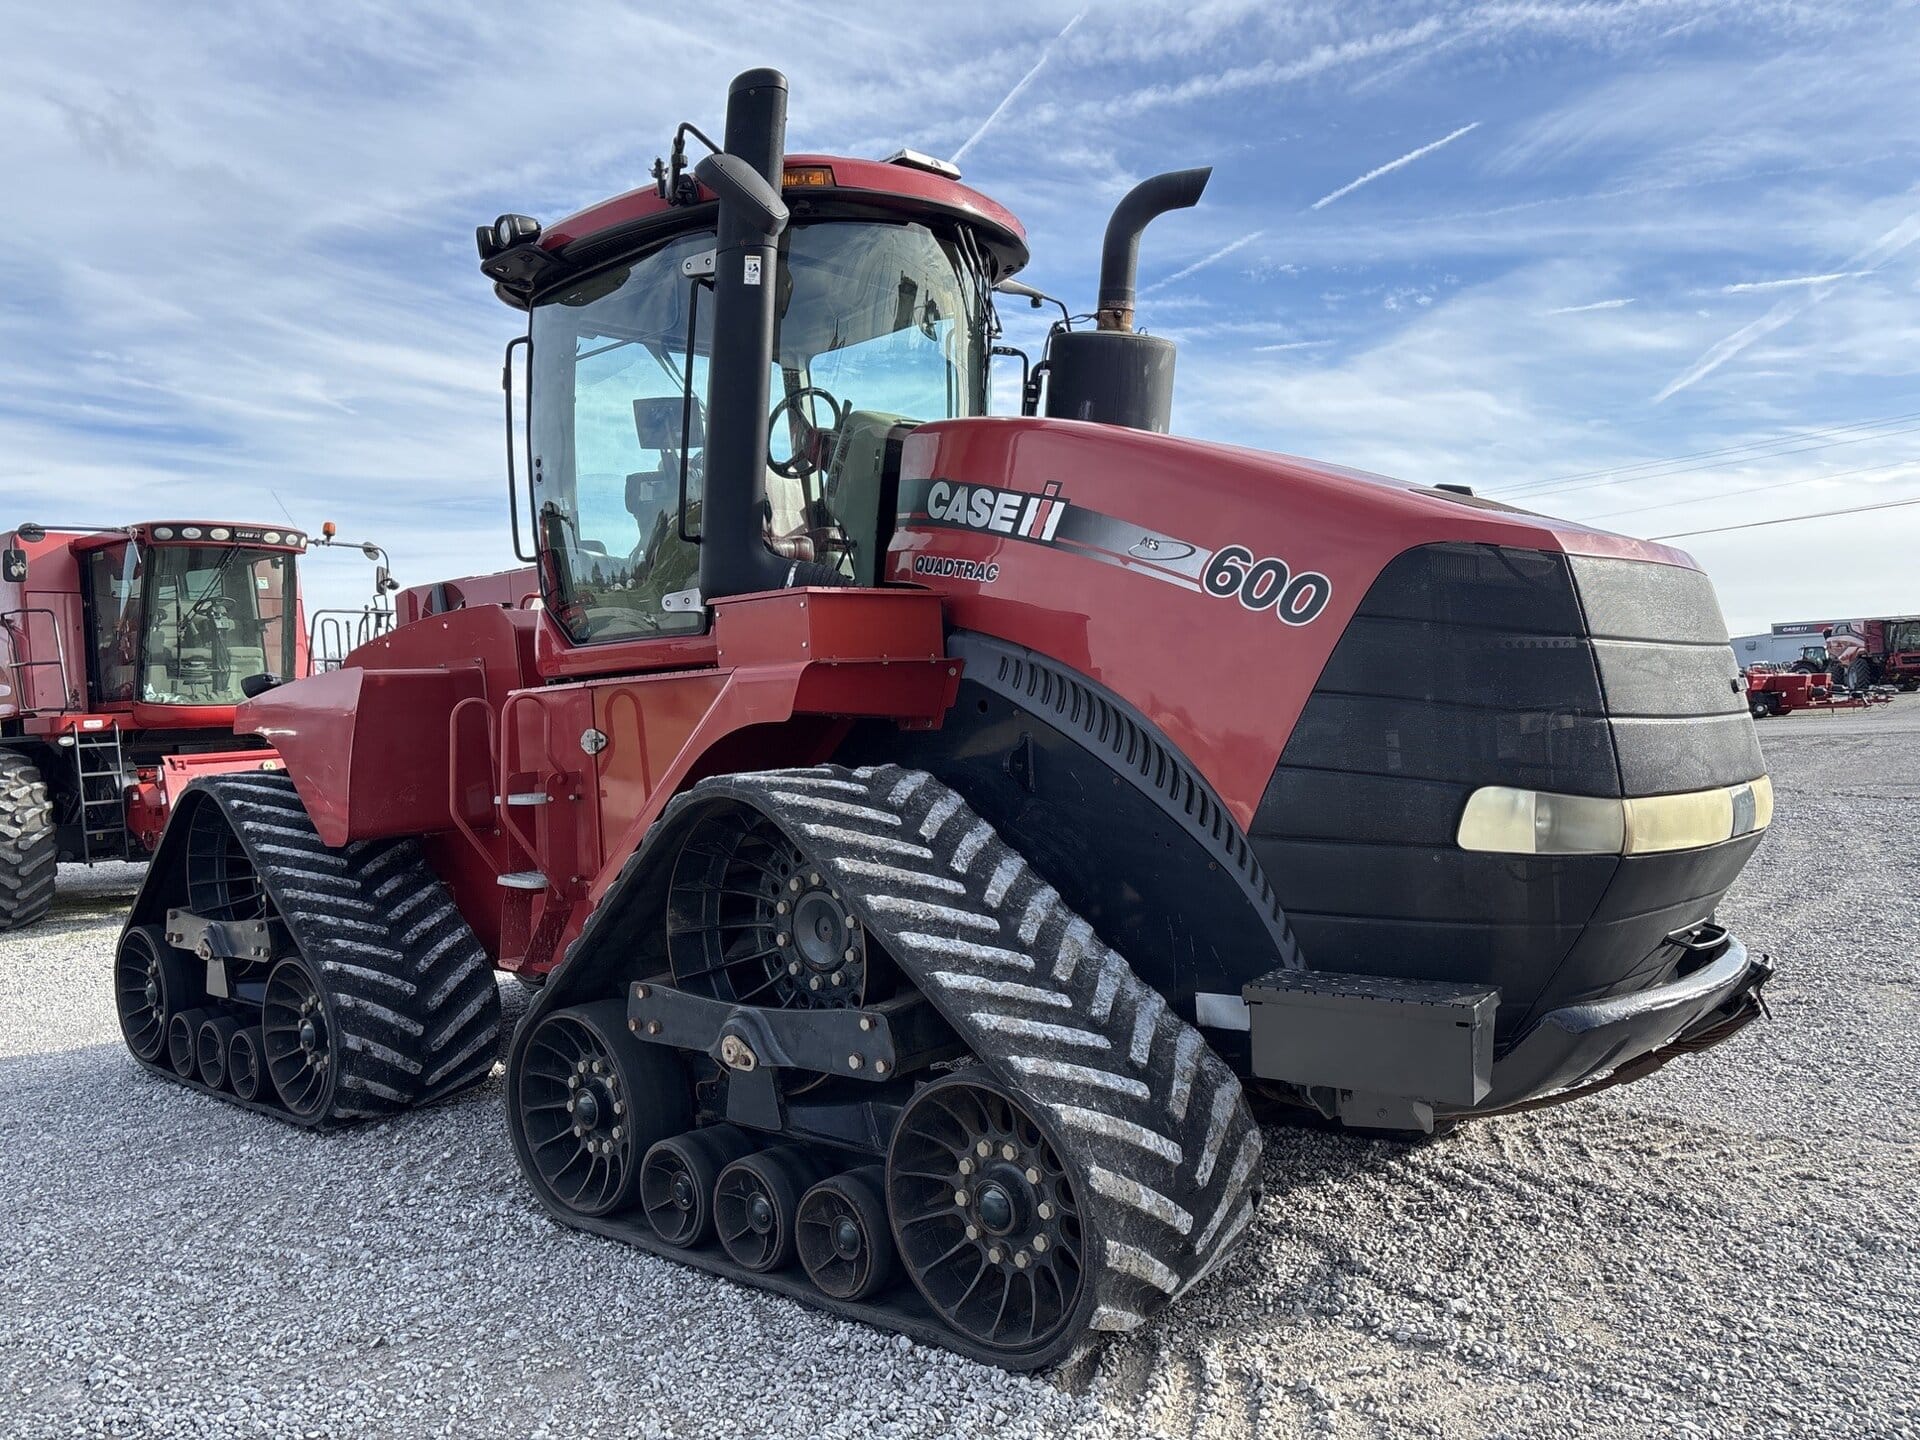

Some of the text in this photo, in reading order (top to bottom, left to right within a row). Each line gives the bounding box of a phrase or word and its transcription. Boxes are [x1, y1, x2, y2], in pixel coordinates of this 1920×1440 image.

[927, 481, 1023, 533] CASE
[1139, 536, 1160, 551] AFS
[914, 555, 999, 583] QUADTRAC
[1203, 544, 1332, 627] 600
